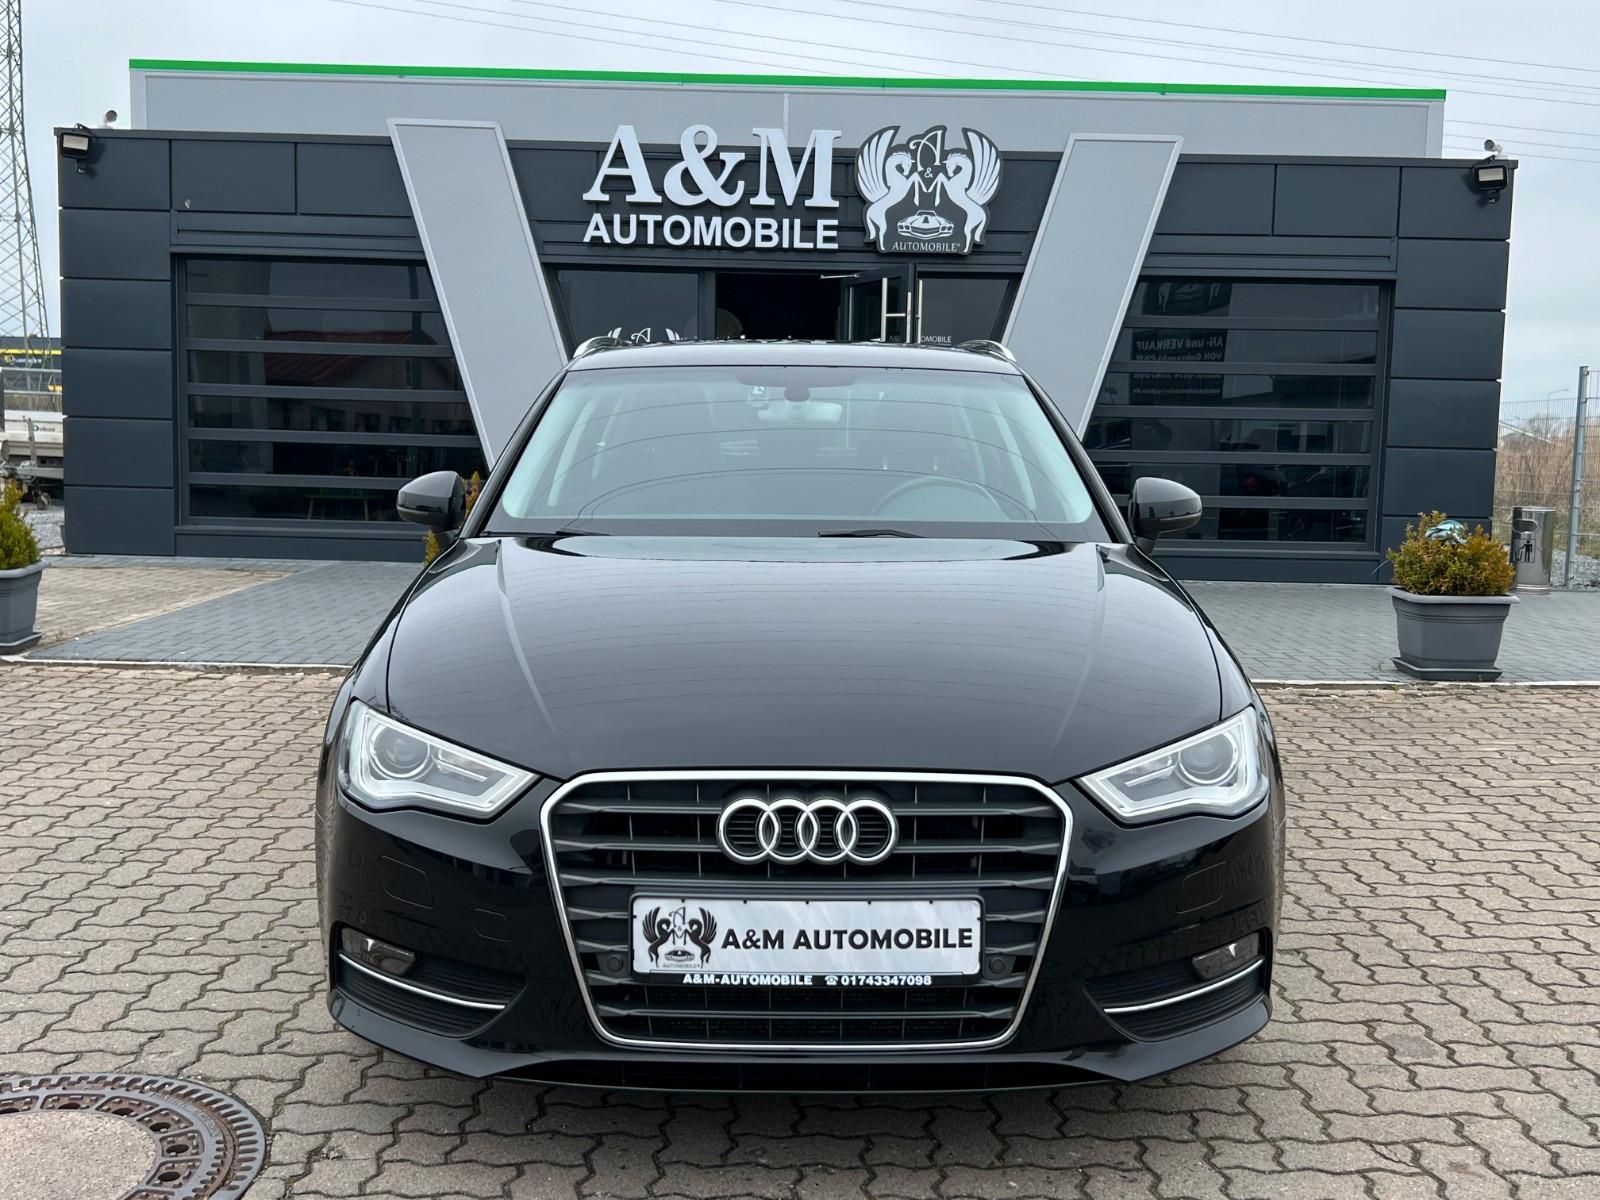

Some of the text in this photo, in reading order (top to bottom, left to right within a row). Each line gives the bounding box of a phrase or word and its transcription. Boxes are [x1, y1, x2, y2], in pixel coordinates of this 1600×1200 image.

[582, 124, 842, 208] A&M
[582, 213, 839, 250] AUTOMOBILE
[920, 335, 952, 343] OMOBILE
[721, 927, 973, 950] A&M AUTOMOBILE
[682, 973, 932, 986] A&M-AUTOMOBILE 01743347098
